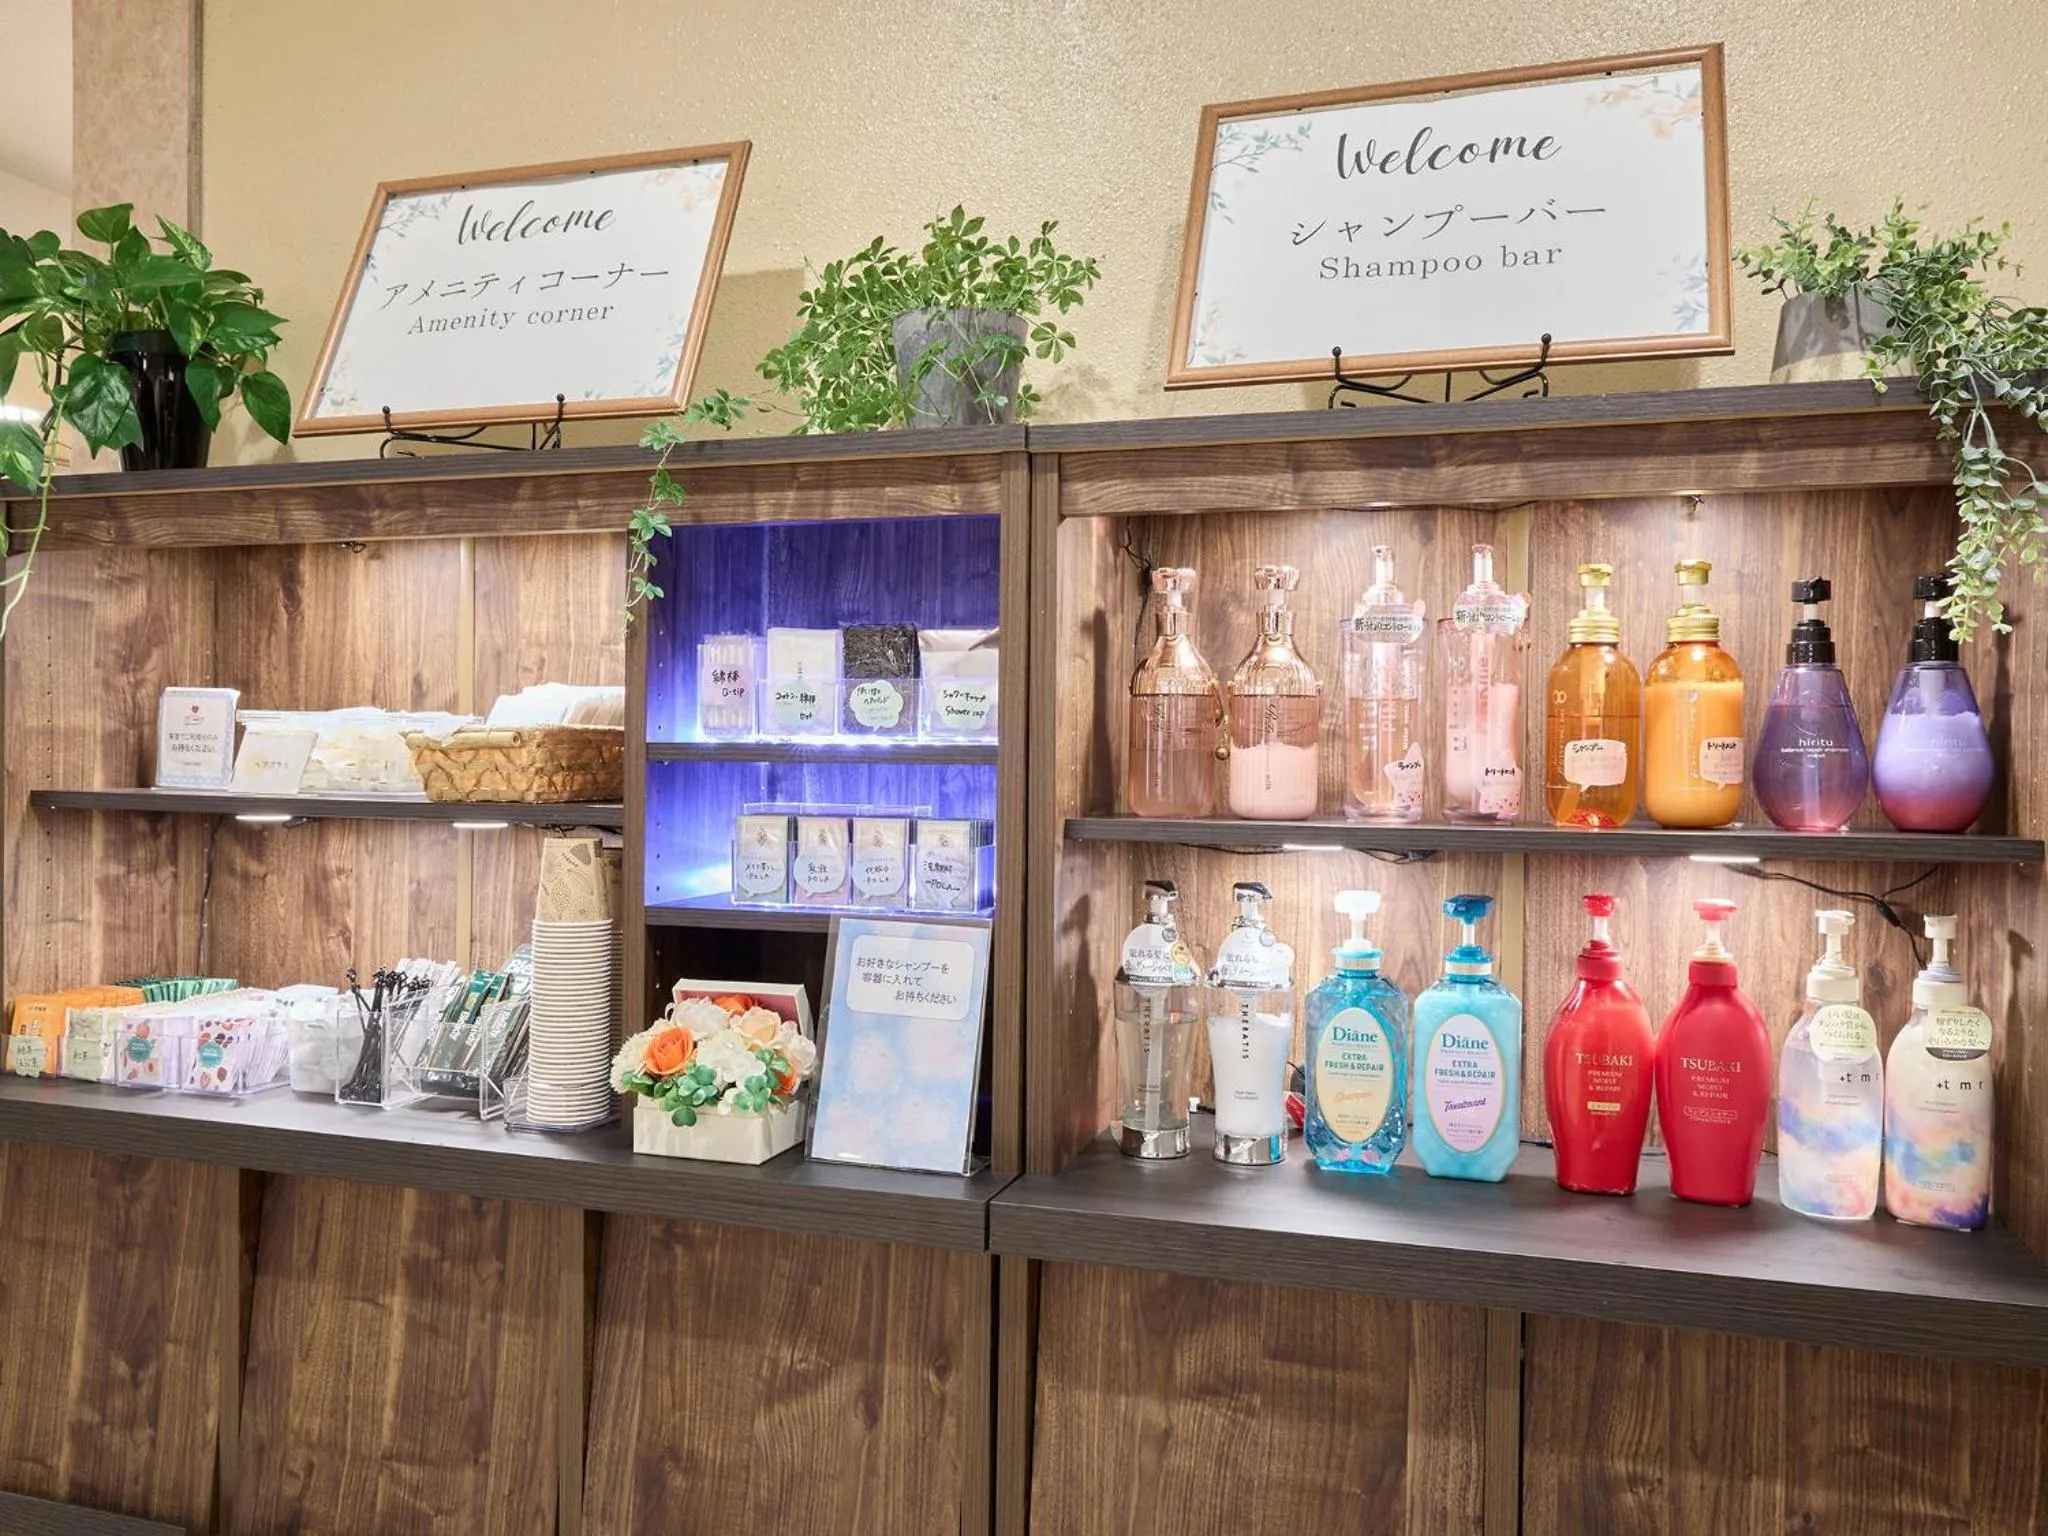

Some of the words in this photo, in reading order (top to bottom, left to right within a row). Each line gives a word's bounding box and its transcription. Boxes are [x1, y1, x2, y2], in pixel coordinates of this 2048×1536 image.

[1336, 125, 1562, 180] Welcome
[457, 199, 617, 246] Welcome
[1290, 197, 1607, 247] シャンプーバー
[1319, 253, 1483, 286] Shampoo
[1501, 244, 1563, 268] bar
[381, 262, 670, 310] アメニティコーナー
[408, 308, 518, 336] Amenity
[527, 304, 615, 325] corner
[1799, 738, 1833, 747] hiritu
[857, 957, 950, 974] お好きなシャンプーを
[863, 972, 924, 987] 容器に入れて
[895, 990, 957, 1005] お持ちください
[1241, 1004, 1249, 1059] THERATIS
[1452, 1060, 1478, 1069] EXTRA
[1575, 1052, 1633, 1067] TSUBAKI
[1680, 1057, 1742, 1073] TSUBAKI
